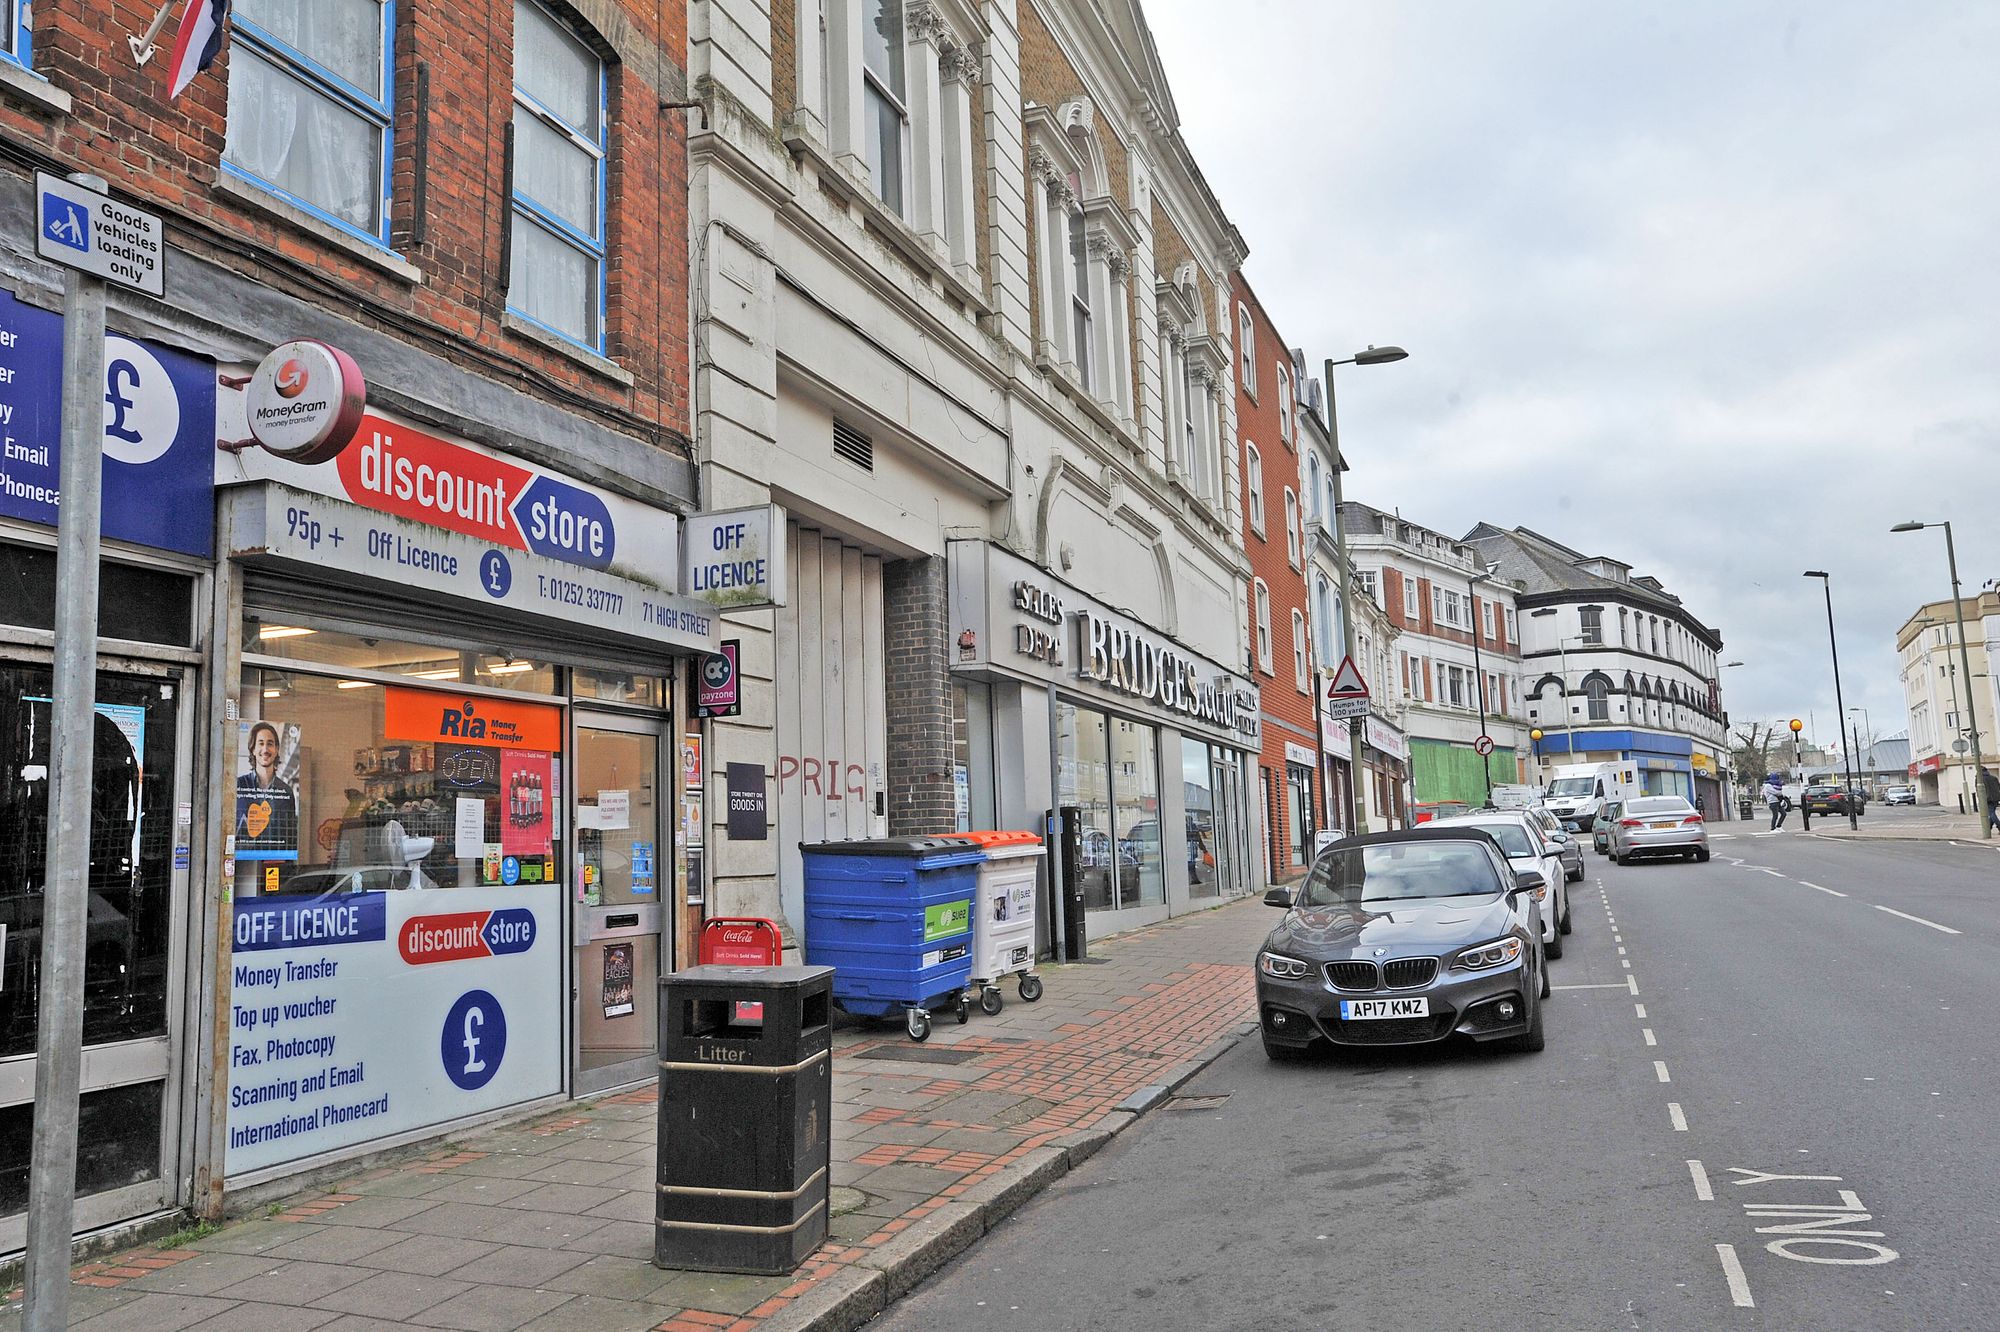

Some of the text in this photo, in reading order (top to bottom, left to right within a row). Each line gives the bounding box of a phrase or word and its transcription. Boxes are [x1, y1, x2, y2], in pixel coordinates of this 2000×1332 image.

[101, 204, 150, 232] Goods
[94, 220, 157, 252] vehicles
[98, 236, 155, 270] loading
[111, 261, 143, 283] only
[257, 400, 327, 420] MoneyGram
[265, 415, 316, 428] money transfer
[5, 437, 49, 467] Email
[0, 473, 60, 506] Phoneca
[360, 432, 604, 558] discount store
[287, 507, 321, 550] 95p
[713, 524, 746, 551] OFF
[368, 529, 458, 577] Off Licence
[693, 559, 765, 591] LICENCE
[537, 575, 623, 616] T: 01252 337777
[642, 601, 711, 637] 71 HIGH STREET
[700, 691, 734, 702] payzone
[1333, 701, 1354, 709] Humps
[1348, 707, 1366, 715] yards
[440, 701, 486, 739] Ria
[491, 719, 517, 730] Money
[491, 731, 523, 743] Transfer
[442, 757, 495, 780] OPEN
[731, 798, 764, 811] GOODS IN
[236, 906, 359, 945] OFF LICENCE
[409, 919, 531, 954] discount store
[235, 959, 338, 989] Money Transfer
[606, 969, 629, 980] EAGLES
[234, 996, 337, 1031] Top up voucher
[1353, 999, 1423, 1017] AP17 KMZ
[267, 1034, 336, 1060] Photocopy
[700, 1046, 746, 1062] Litter
[232, 1062, 364, 1109] Scanning and Email
[231, 1093, 389, 1149] International Phonecard
[1726, 1167, 1900, 1265] ONLY
